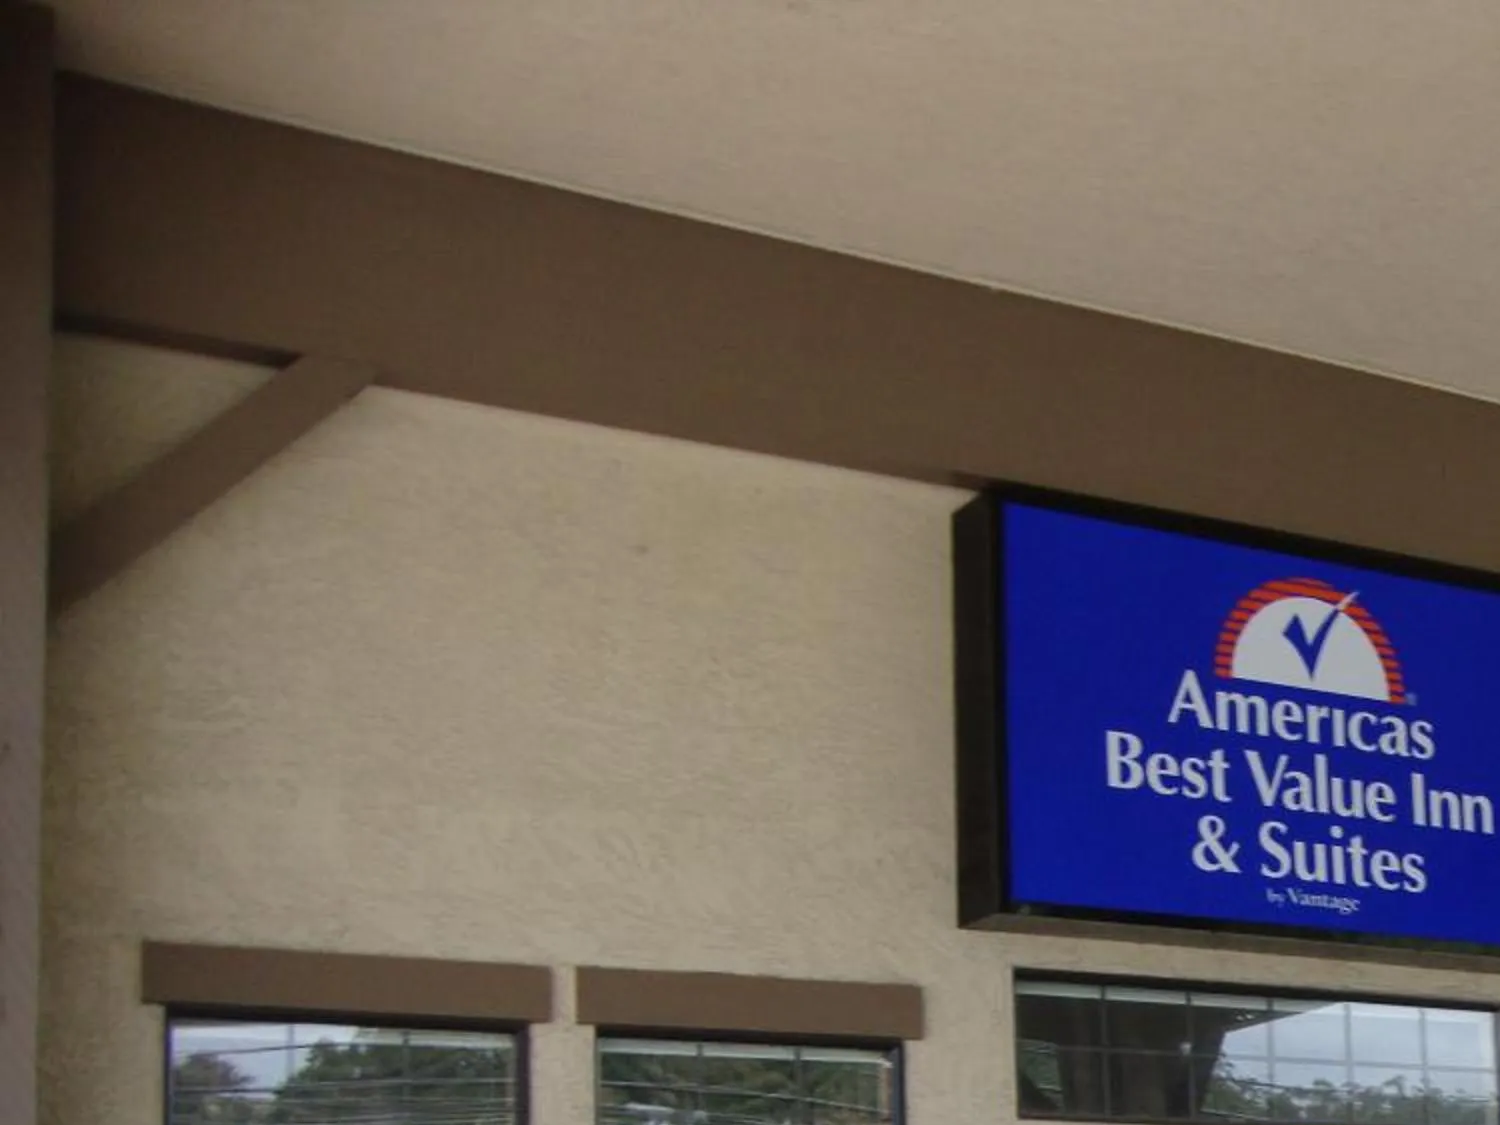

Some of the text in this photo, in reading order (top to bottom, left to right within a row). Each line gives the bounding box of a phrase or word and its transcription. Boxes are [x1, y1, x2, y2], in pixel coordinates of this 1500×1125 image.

[1167, 669, 1434, 760] Americas
[1105, 730, 1494, 835] Best Value Inn
[1191, 814, 1427, 894] & Suites
[1266, 888, 1361, 915] by Vantage
